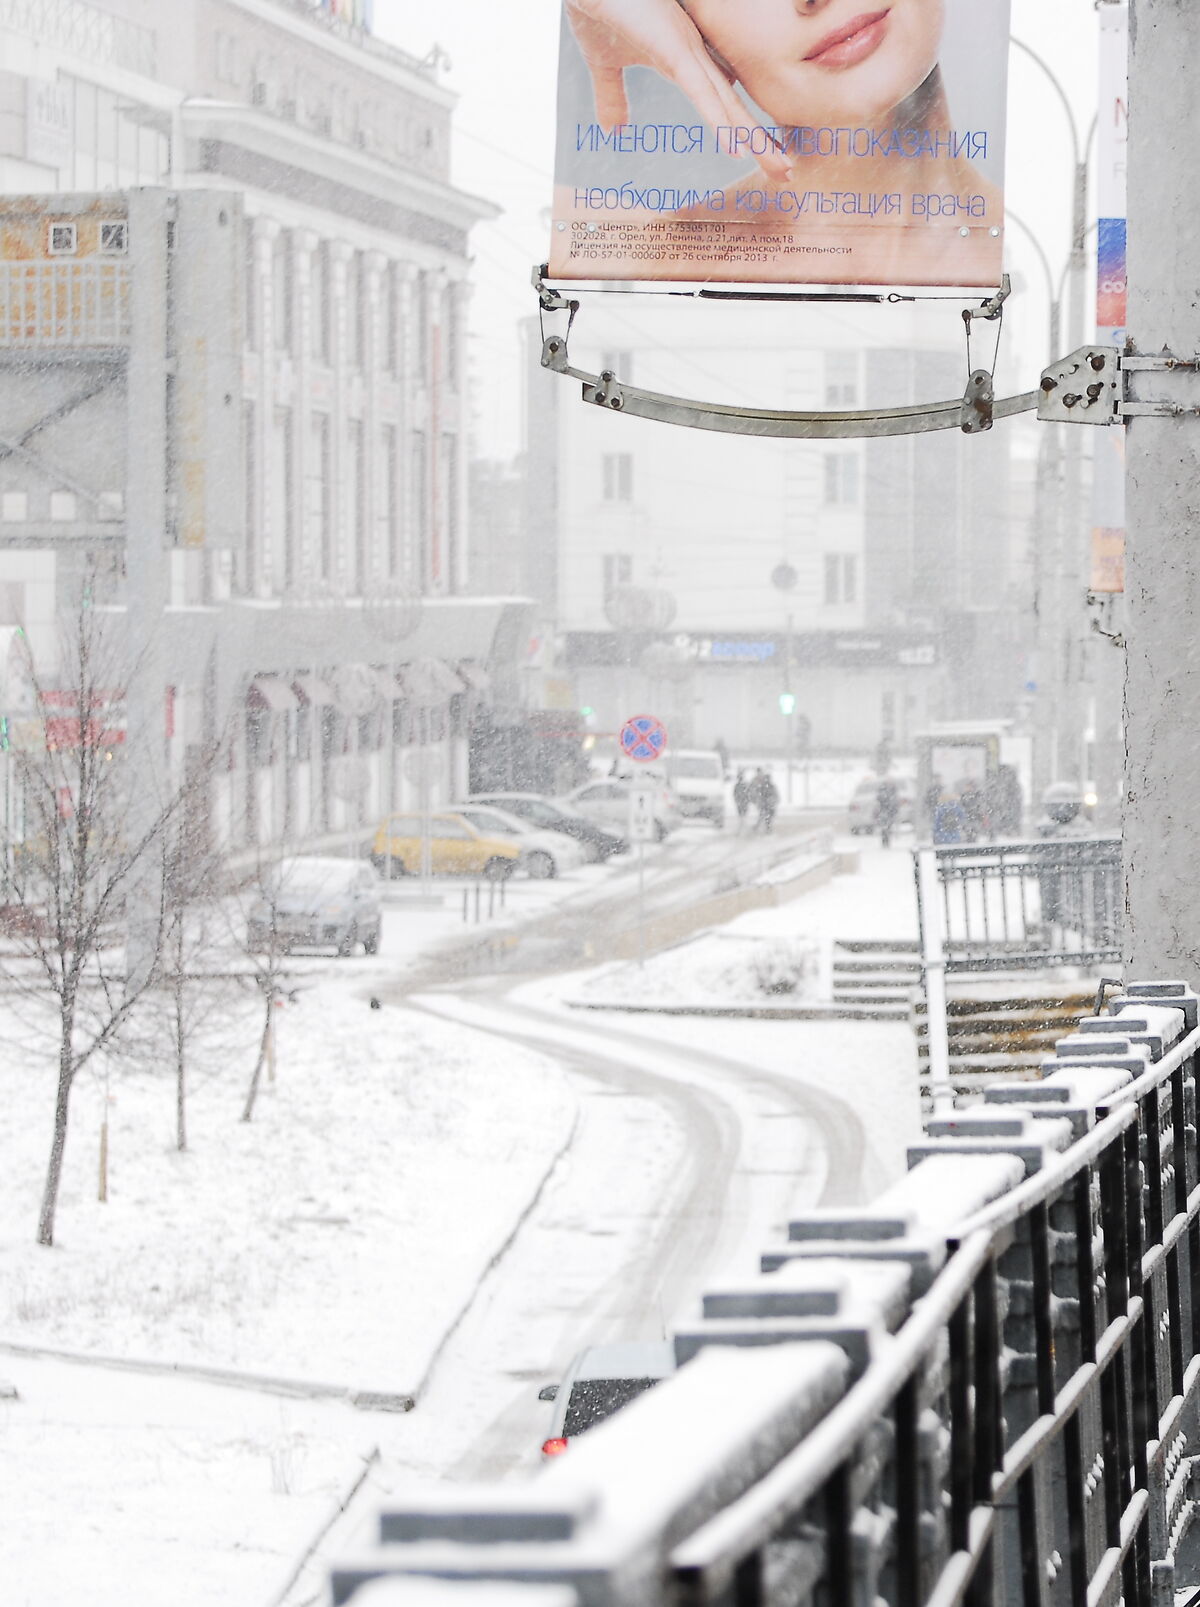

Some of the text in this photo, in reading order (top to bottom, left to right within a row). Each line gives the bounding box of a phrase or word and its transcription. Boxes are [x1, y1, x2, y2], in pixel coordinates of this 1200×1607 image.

[576, 123, 988, 159] ИМЕЮТСЯ ПРОТИВОПОКАЗАНИЯ
[574, 181, 986, 221] необходима консультация врача
[571, 222, 596, 232] ОО
[643, 223, 666, 232] ИНН
[750, 235, 757, 243] А
[570, 241, 619, 251] Лицензия
[634, 243, 711, 252] осуществление
[713, 244, 781, 253] медицинской
[783, 246, 852, 255] деятельности
[682, 252, 694, 260] 26
[696, 252, 742, 263] сентября
[744, 254, 768, 262] 2013
